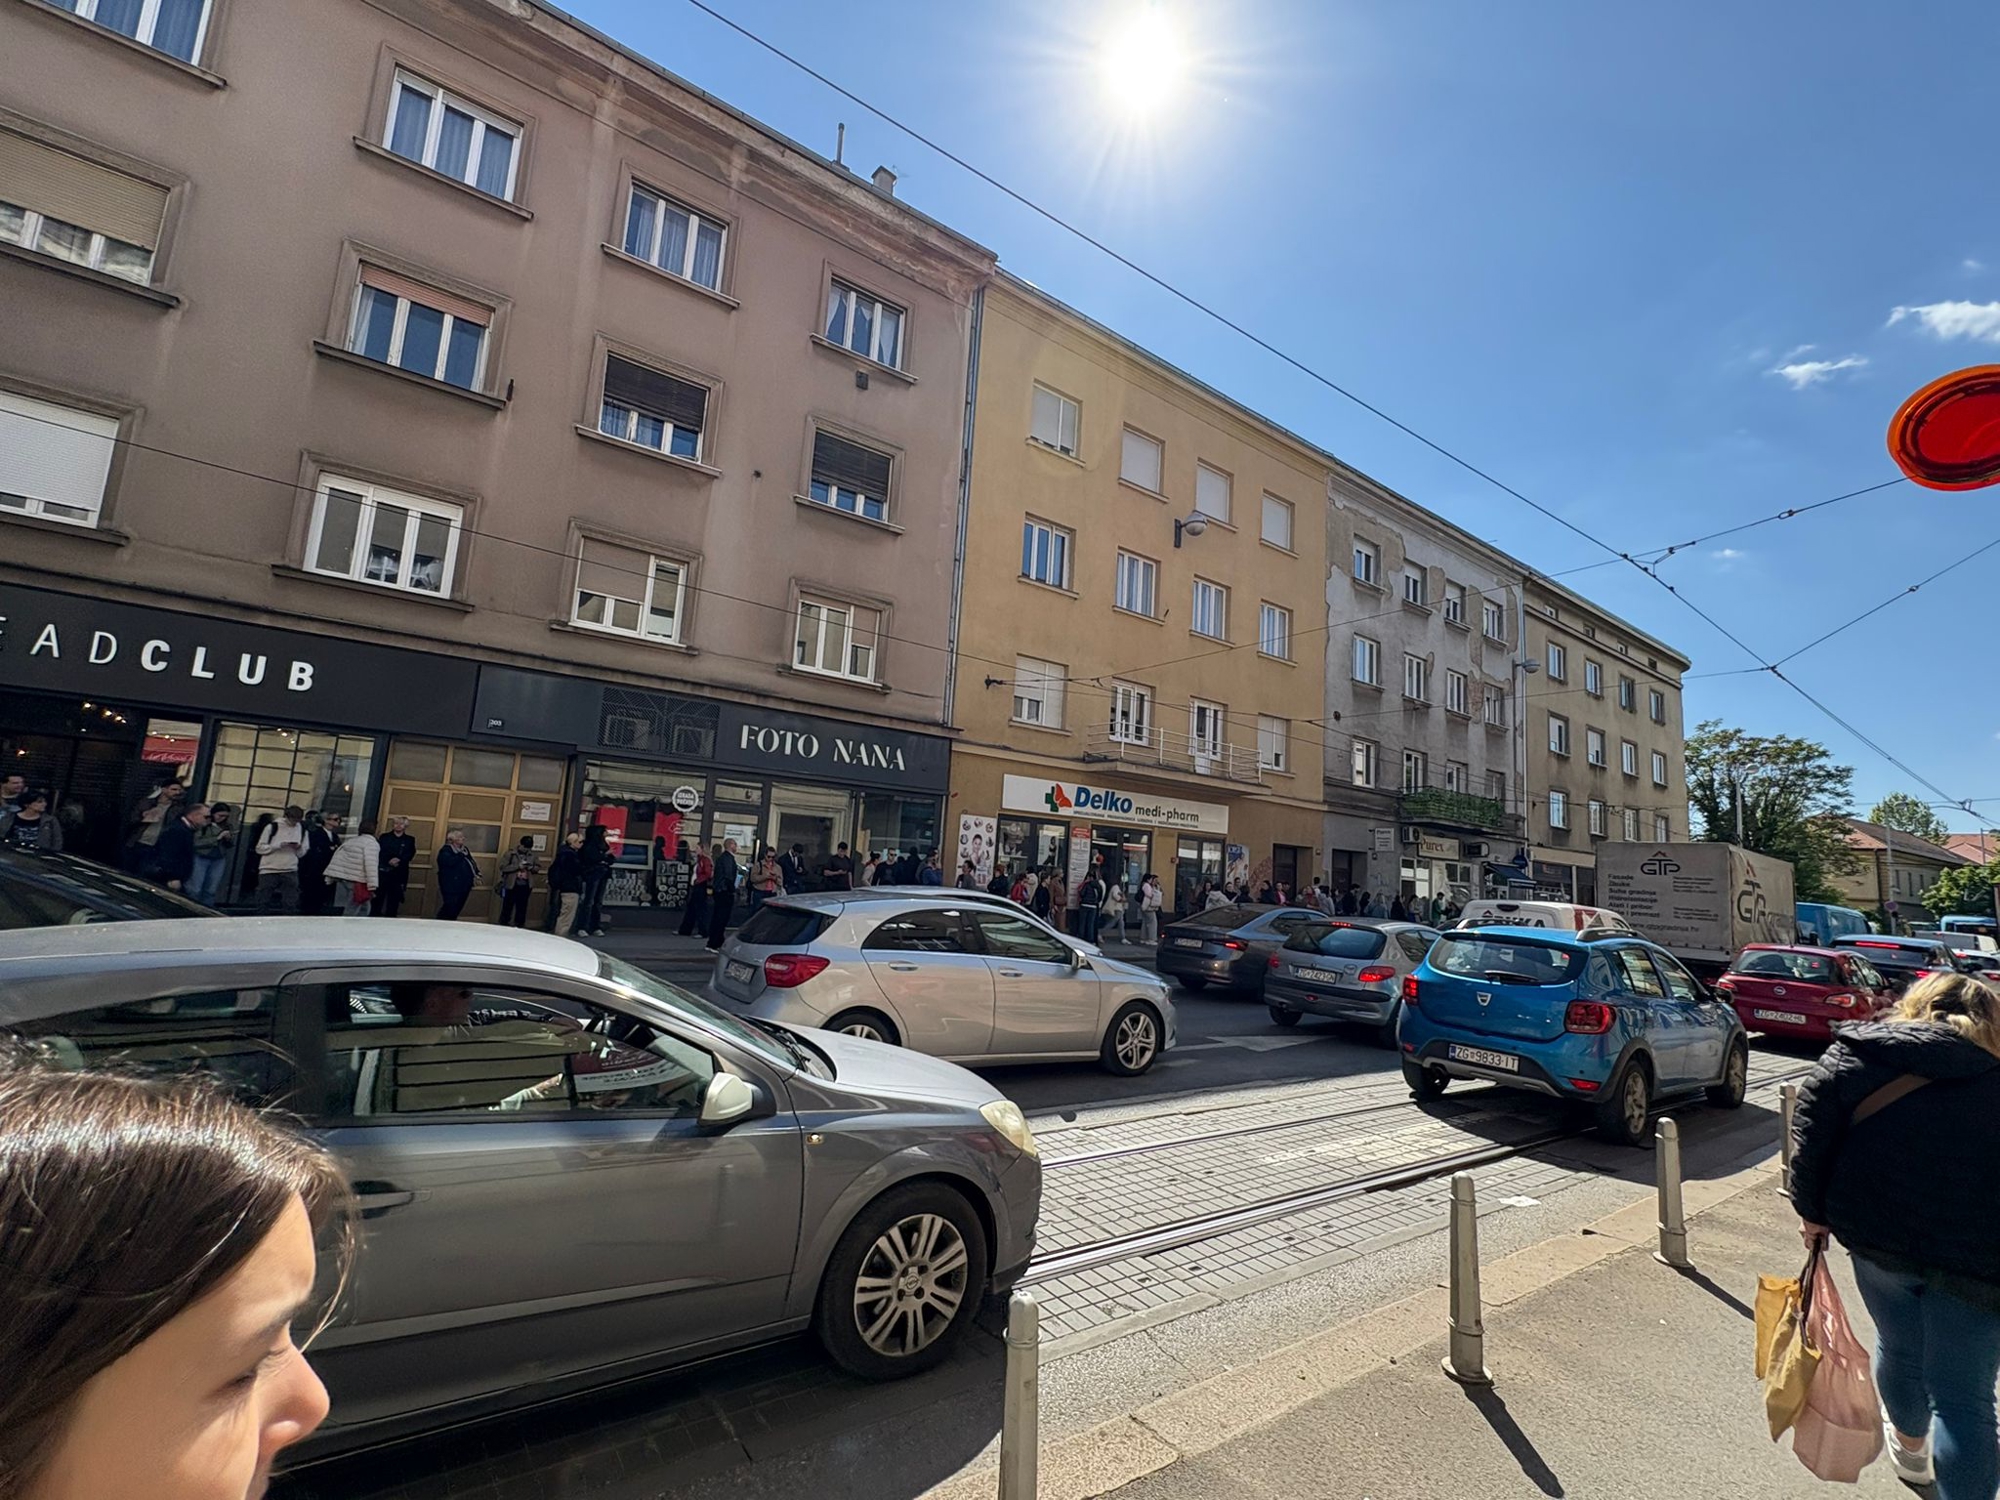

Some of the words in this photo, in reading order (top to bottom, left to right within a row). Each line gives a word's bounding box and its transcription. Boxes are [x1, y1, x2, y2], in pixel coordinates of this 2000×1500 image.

[740, 724, 820, 759] FOTO
[832, 738, 906, 771] NANA
[1074, 786, 1133, 813] Delko
[1135, 805, 1200, 822] medi-pharm
[1641, 858, 1681, 875] GTP
[1456, 1047, 1469, 1059] ZG
